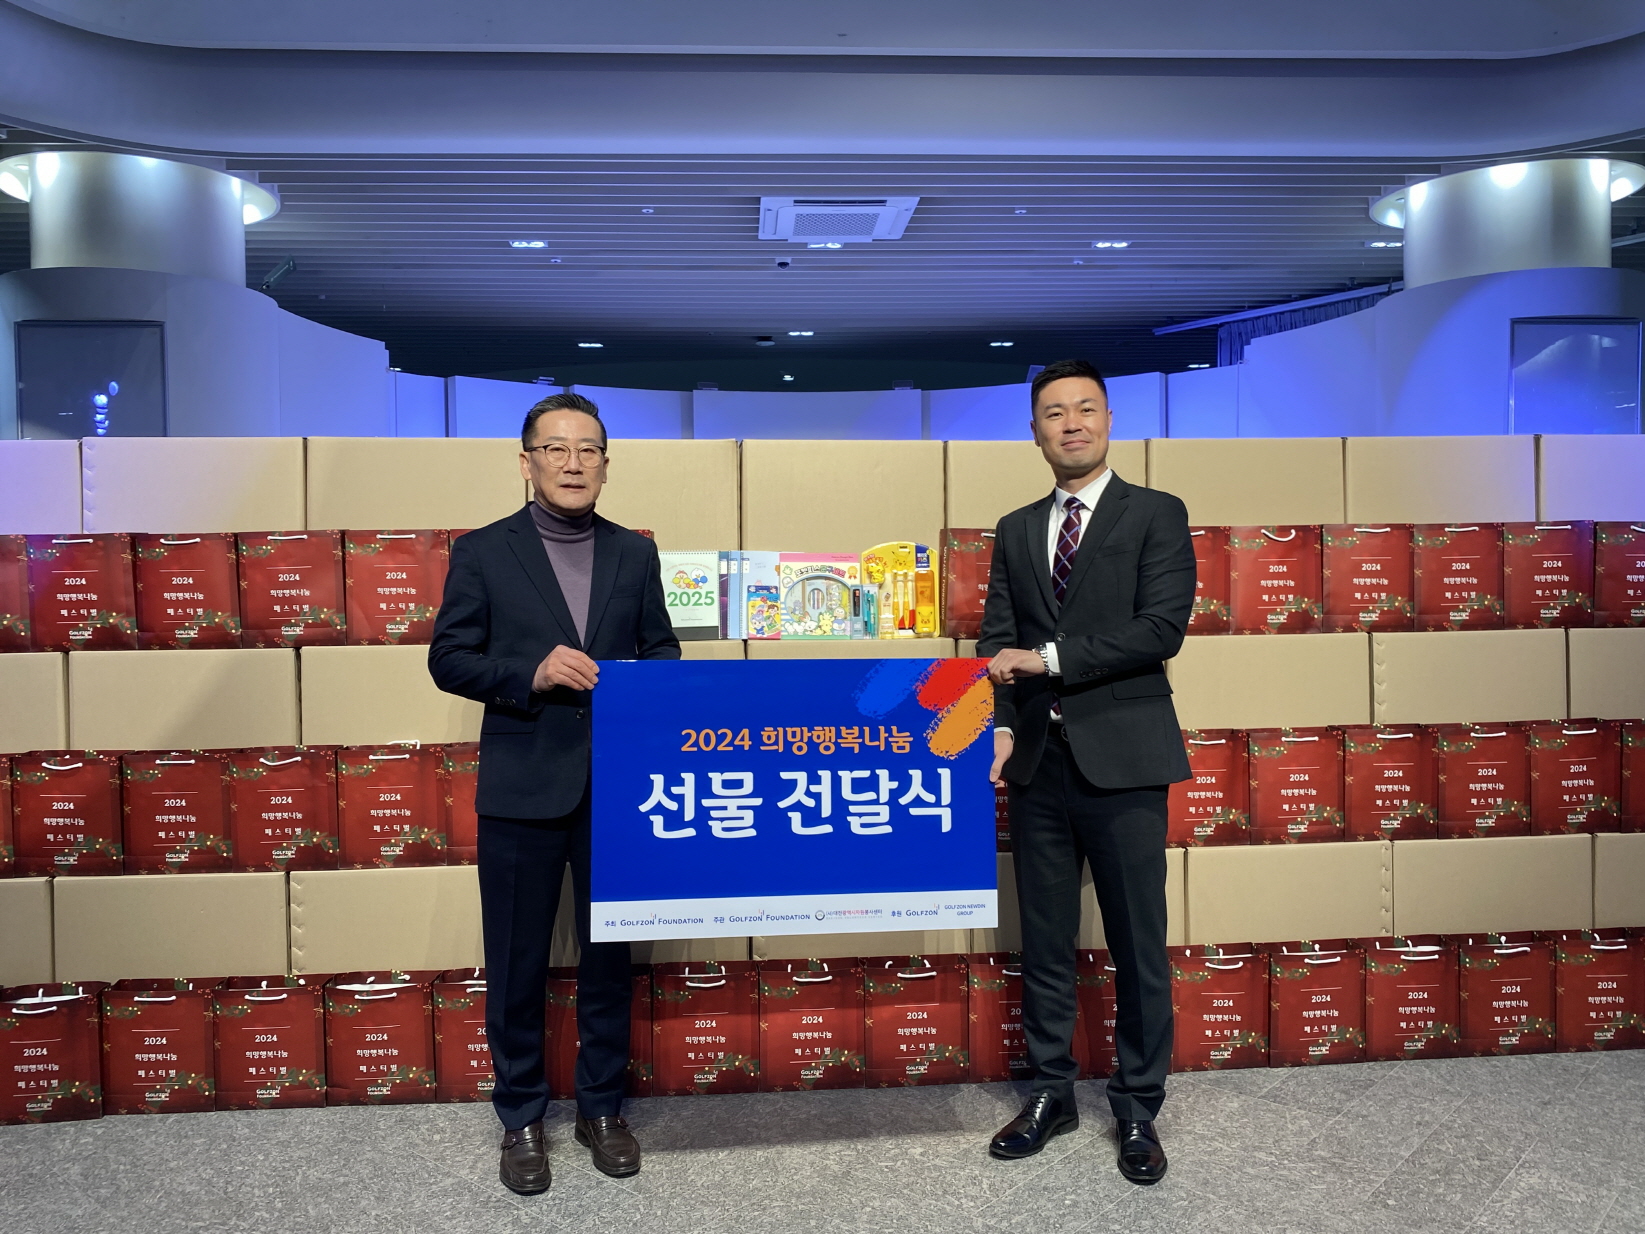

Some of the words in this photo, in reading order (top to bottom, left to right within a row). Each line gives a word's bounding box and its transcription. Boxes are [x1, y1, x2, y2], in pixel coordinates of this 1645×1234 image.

[1353, 578, 1389, 586] 희망행복나눔
[1534, 575, 1570, 583] 희망행복나눔
[1626, 574, 1645, 582] 희망행
[1261, 580, 1295, 588] 희망행복나눔
[271, 589, 311, 597] 희망행복나눔
[377, 587, 417, 595] 희망행복나눔
[1627, 589, 1643, 597] 페스
[57, 593, 98, 601] 희망행복나눔
[164, 593, 205, 601] 희망행복나눔
[667, 591, 715, 607] 2025
[680, 728, 752, 752] 2024
[759, 726, 914, 755] 희망행복나눔
[1469, 783, 1505, 791] 희망행복나눔
[1562, 779, 1595, 787] 희망행복나눔
[1281, 789, 1317, 797] 희망행복나눔
[1375, 785, 1411, 793] 희망행복나눔
[638, 771, 763, 839] 선물
[776, 767, 952, 836] 전달식
[262, 812, 303, 820] 희망행복나눔
[371, 809, 411, 817] 희망행복나눔
[44, 818, 85, 826] 희망행복나눔
[156, 815, 197, 823] 희망행복나눔
[891, 910, 902, 918] 후원
[906, 908, 938, 917] GOLFZON
[620, 918, 655, 927] GOLFZON
[658, 917, 704, 925] FOUNDATION
[713, 916, 725, 924] 주관
[729, 914, 763, 923] GOLFZON
[766, 913, 810, 921] FOUNDATION
[1493, 1000, 1529, 1008] 희망행복나눔
[1011, 1008, 1022, 1016] 20
[1303, 1010, 1339, 1018] 희망행복나눔
[1399, 1007, 1436, 1015] 희망행복나눔
[898, 1027, 937, 1035] 희망행복나눔
[686, 1036, 727, 1044] 희망행복나눔
[793, 1032, 833, 1040] 희망행복나눔
[24, 1048, 48, 1056] 2024
[246, 1050, 289, 1058] 희망행복나눔
[357, 1049, 399, 1057] 희망행복나눔
[135, 1053, 178, 1061] 희망행복나눔
[14, 1064, 60, 1072] 희망행복나눔
